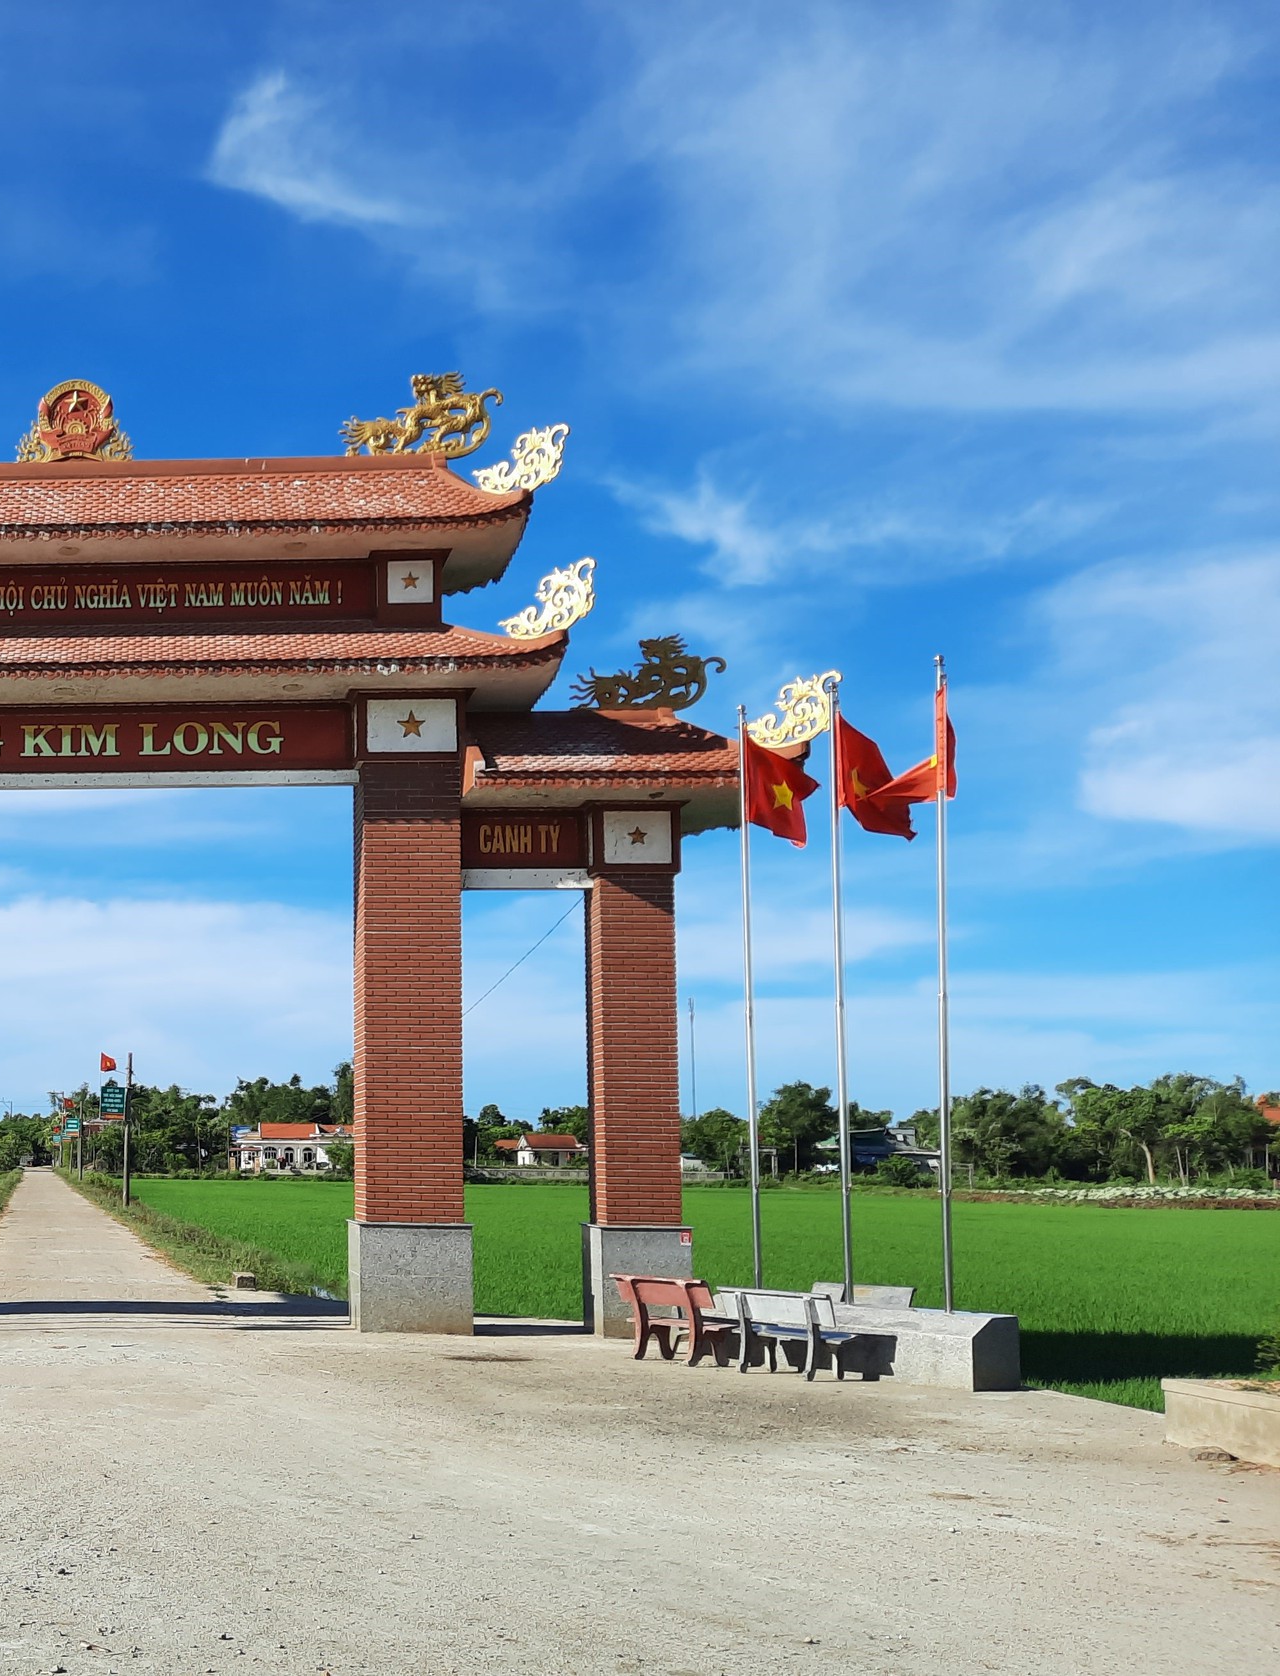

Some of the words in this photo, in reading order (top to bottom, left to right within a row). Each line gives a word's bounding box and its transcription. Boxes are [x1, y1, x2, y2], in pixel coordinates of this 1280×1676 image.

[31, 577, 68, 609] CHỦ
[74, 579, 131, 609] NGHĨA
[137, 578, 179, 613] VIỆT
[184, 583, 224, 607] NAM
[230, 575, 284, 606] MUÔN
[289, 575, 330, 606] NĂM
[20, 723, 120, 757] KIM
[138, 721, 284, 756] LONG
[480, 824, 532, 853] CANH
